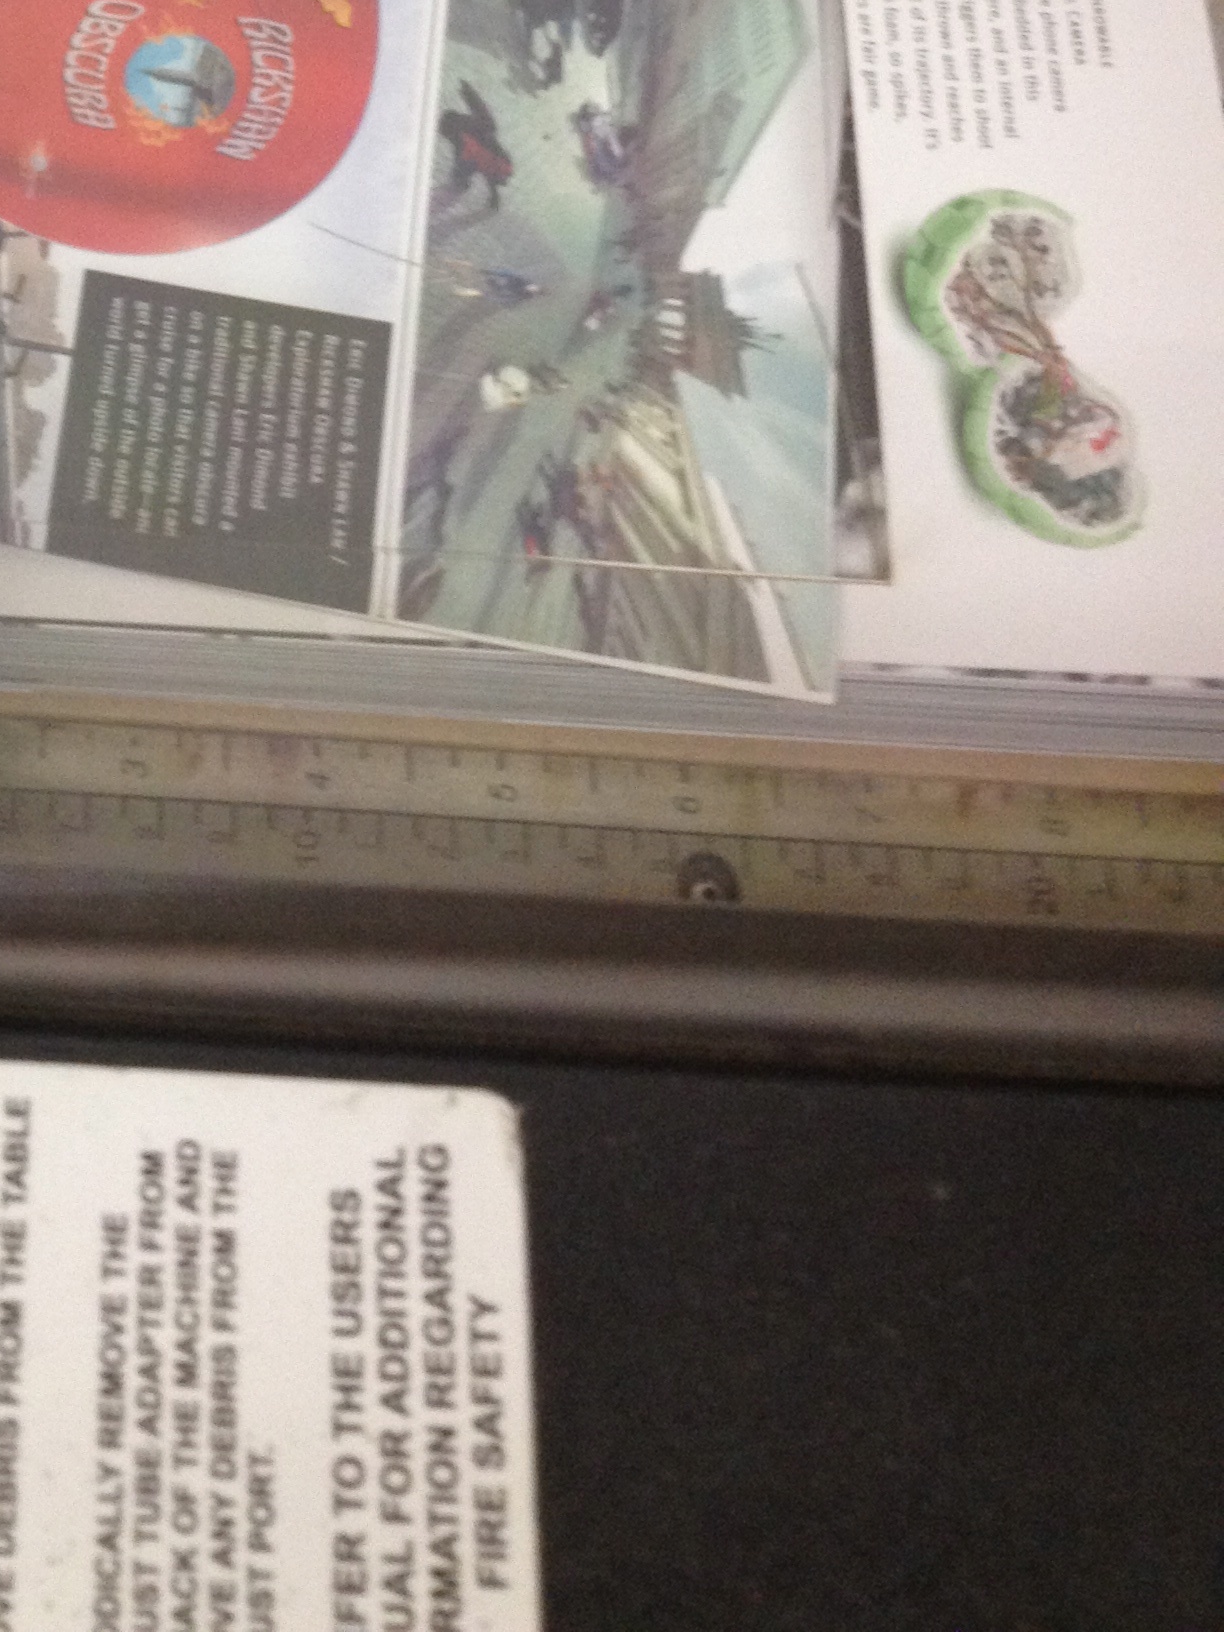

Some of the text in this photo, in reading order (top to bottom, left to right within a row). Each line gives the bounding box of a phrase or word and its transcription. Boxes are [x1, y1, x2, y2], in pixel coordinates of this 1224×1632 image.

[215, 17, 294, 160] RICKSHAW
[0, 1098, 31, 1207] TABLE
[138, 1149, 166, 1253] FROM
[175, 1138, 202, 1214] AND
[211, 1151, 238, 1216] THE
[100, 1214, 129, 1281] THE
[210, 1228, 238, 1334] FROM
[416, 1143, 456, 1411] REGARDING
[135, 1263, 164, 1438] ADAPTER
[173, 1225, 201, 1389] MACHINE
[97, 1294, 128, 1451] REMOVE
[209, 1343, 238, 1481] DEBRIS
[329, 1188, 369, 1632] FER TO THE USERS
[374, 1148, 416, 1632] UAL FOR ADDITIONAL
[172, 1402, 200, 1470] THE
[468, 1295, 508, 1591] FIRE SAFETY
[133, 1447, 162, 1545] TUBE
[171, 1485, 199, 1536] OF
[210, 1491, 236, 1570] ANY
